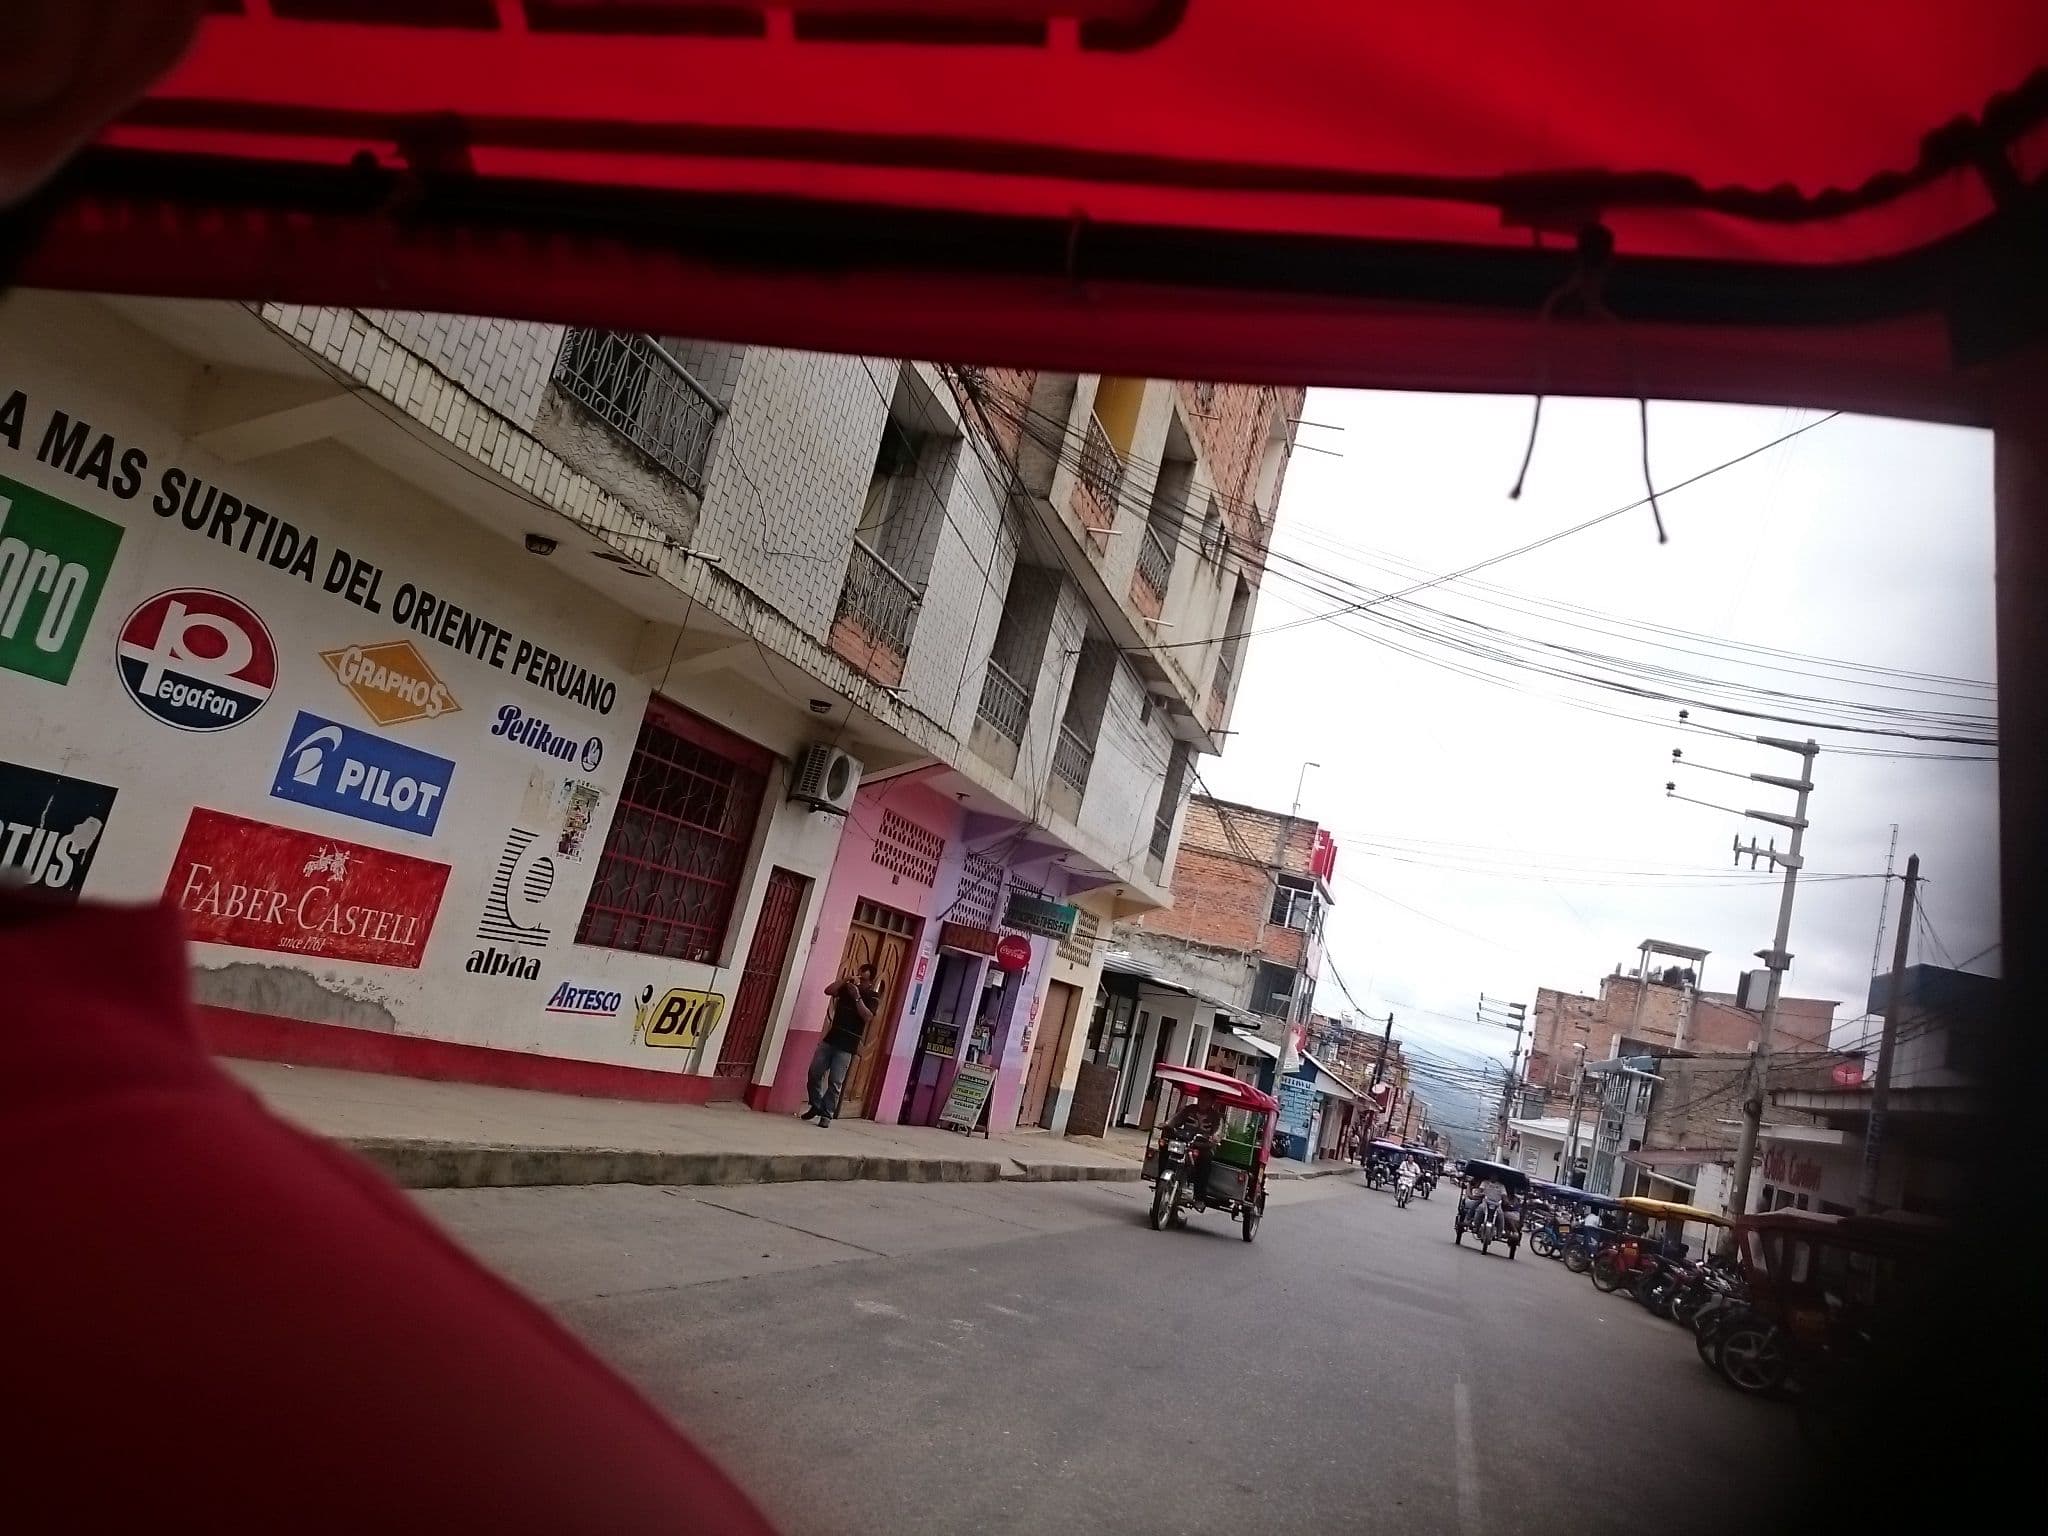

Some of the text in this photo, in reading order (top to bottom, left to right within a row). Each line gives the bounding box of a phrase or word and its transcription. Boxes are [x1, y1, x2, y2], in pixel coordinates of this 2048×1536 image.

[36, 409, 148, 500] MAS
[152, 467, 320, 583] SURTIDA
[322, 547, 384, 614] DEL
[391, 582, 513, 669] ORIENTE
[510, 639, 617, 716] PERUANO
[490, 703, 578, 764] Pelikan
[335, 758, 442, 817] PILOT
[278, 936, 303, 949] since
[546, 981, 622, 1012] ARTESCO
